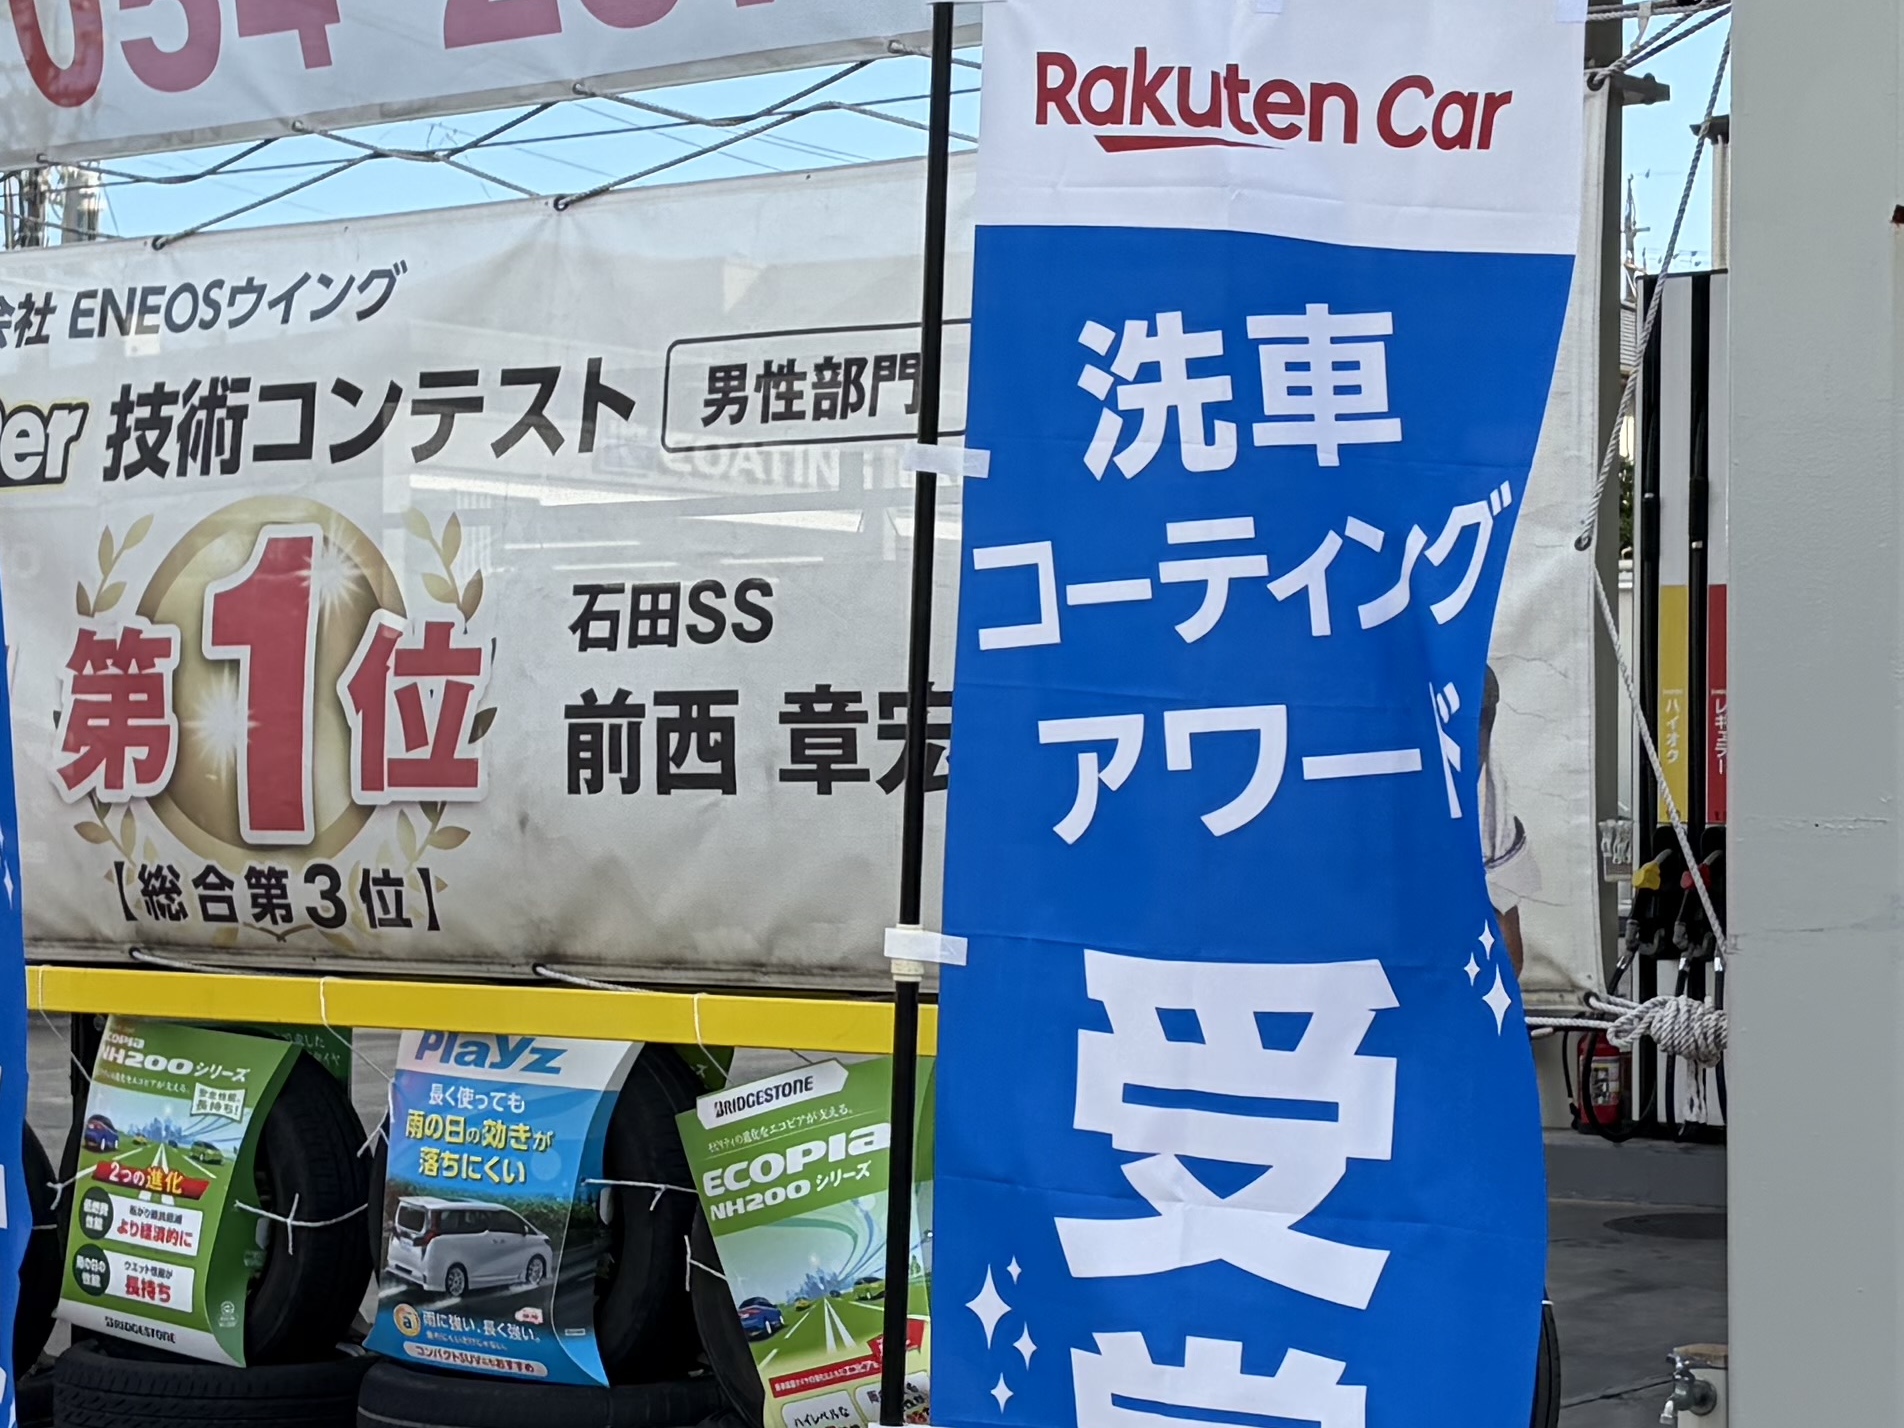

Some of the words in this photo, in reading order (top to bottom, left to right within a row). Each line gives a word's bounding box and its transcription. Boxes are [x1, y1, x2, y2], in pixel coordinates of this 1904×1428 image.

[1034, 46, 1358, 147] Rakuten
[1376, 74, 1513, 152] Car
[68, 259, 409, 340] ENEOSウイング
[102, 356, 638, 483] 技術コンテスト
[700, 351, 922, 428] 男性部門
[1076, 303, 1403, 482] 洗車
[972, 480, 1513, 652] コーティング
[568, 577, 774, 653] 石田SS
[58, 530, 485, 836] 第1位
[564, 687, 740, 796] 前西
[1037, 682, 1463, 846] アワード
[112, 861, 443, 931] 【総合第3位】
[195, 1060, 251, 1083] シリーズ
[414, 1030, 569, 1075] Playz
[428, 1083, 526, 1114] 長く使っても
[713, 1075, 814, 1119] BRIDGESTONE
[405, 1108, 555, 1153] 雨の日の効きが
[109, 1162, 185, 1195] 2つの進化
[418, 1146, 526, 1185] 落ちにくい
[710, 1178, 812, 1222] NH200
[815, 1159, 873, 1192] シリーズ
[116, 1218, 193, 1248] より経済的に
[124, 1274, 172, 1304] 長持ち
[104, 1315, 177, 1345] BRIDGESTONE
